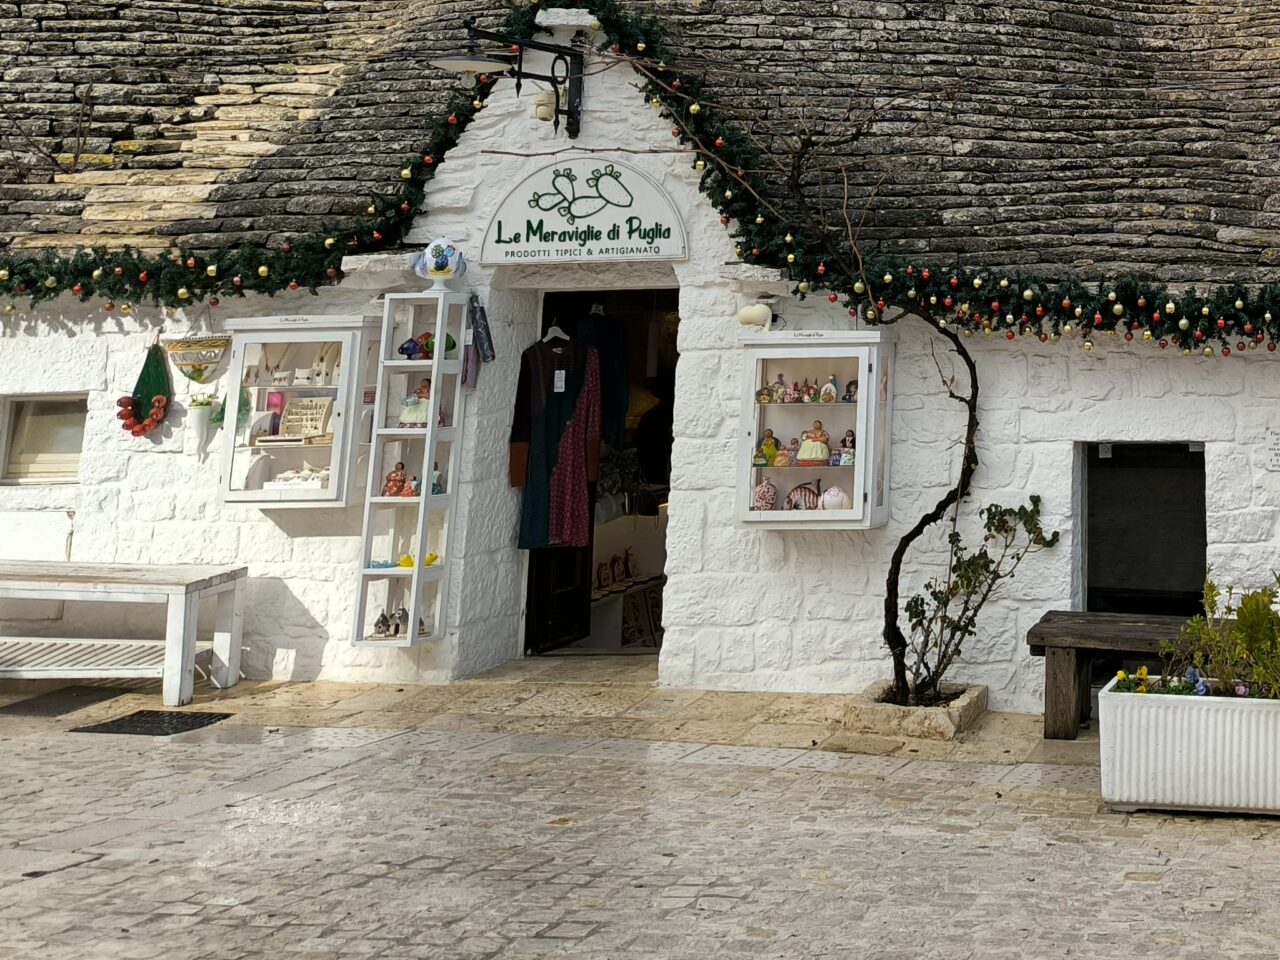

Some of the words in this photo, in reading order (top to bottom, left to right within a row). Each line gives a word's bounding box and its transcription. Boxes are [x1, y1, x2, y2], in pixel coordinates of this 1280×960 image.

[495, 220, 521, 244] Le
[526, 218, 602, 247] Meraviglie
[607, 223, 620, 240] di
[625, 216, 671, 245] Puglia
[505, 248, 550, 258] PRODOTTI
[555, 248, 582, 257] TIPICI
[598, 246, 661, 256] ARTIGIANATO
